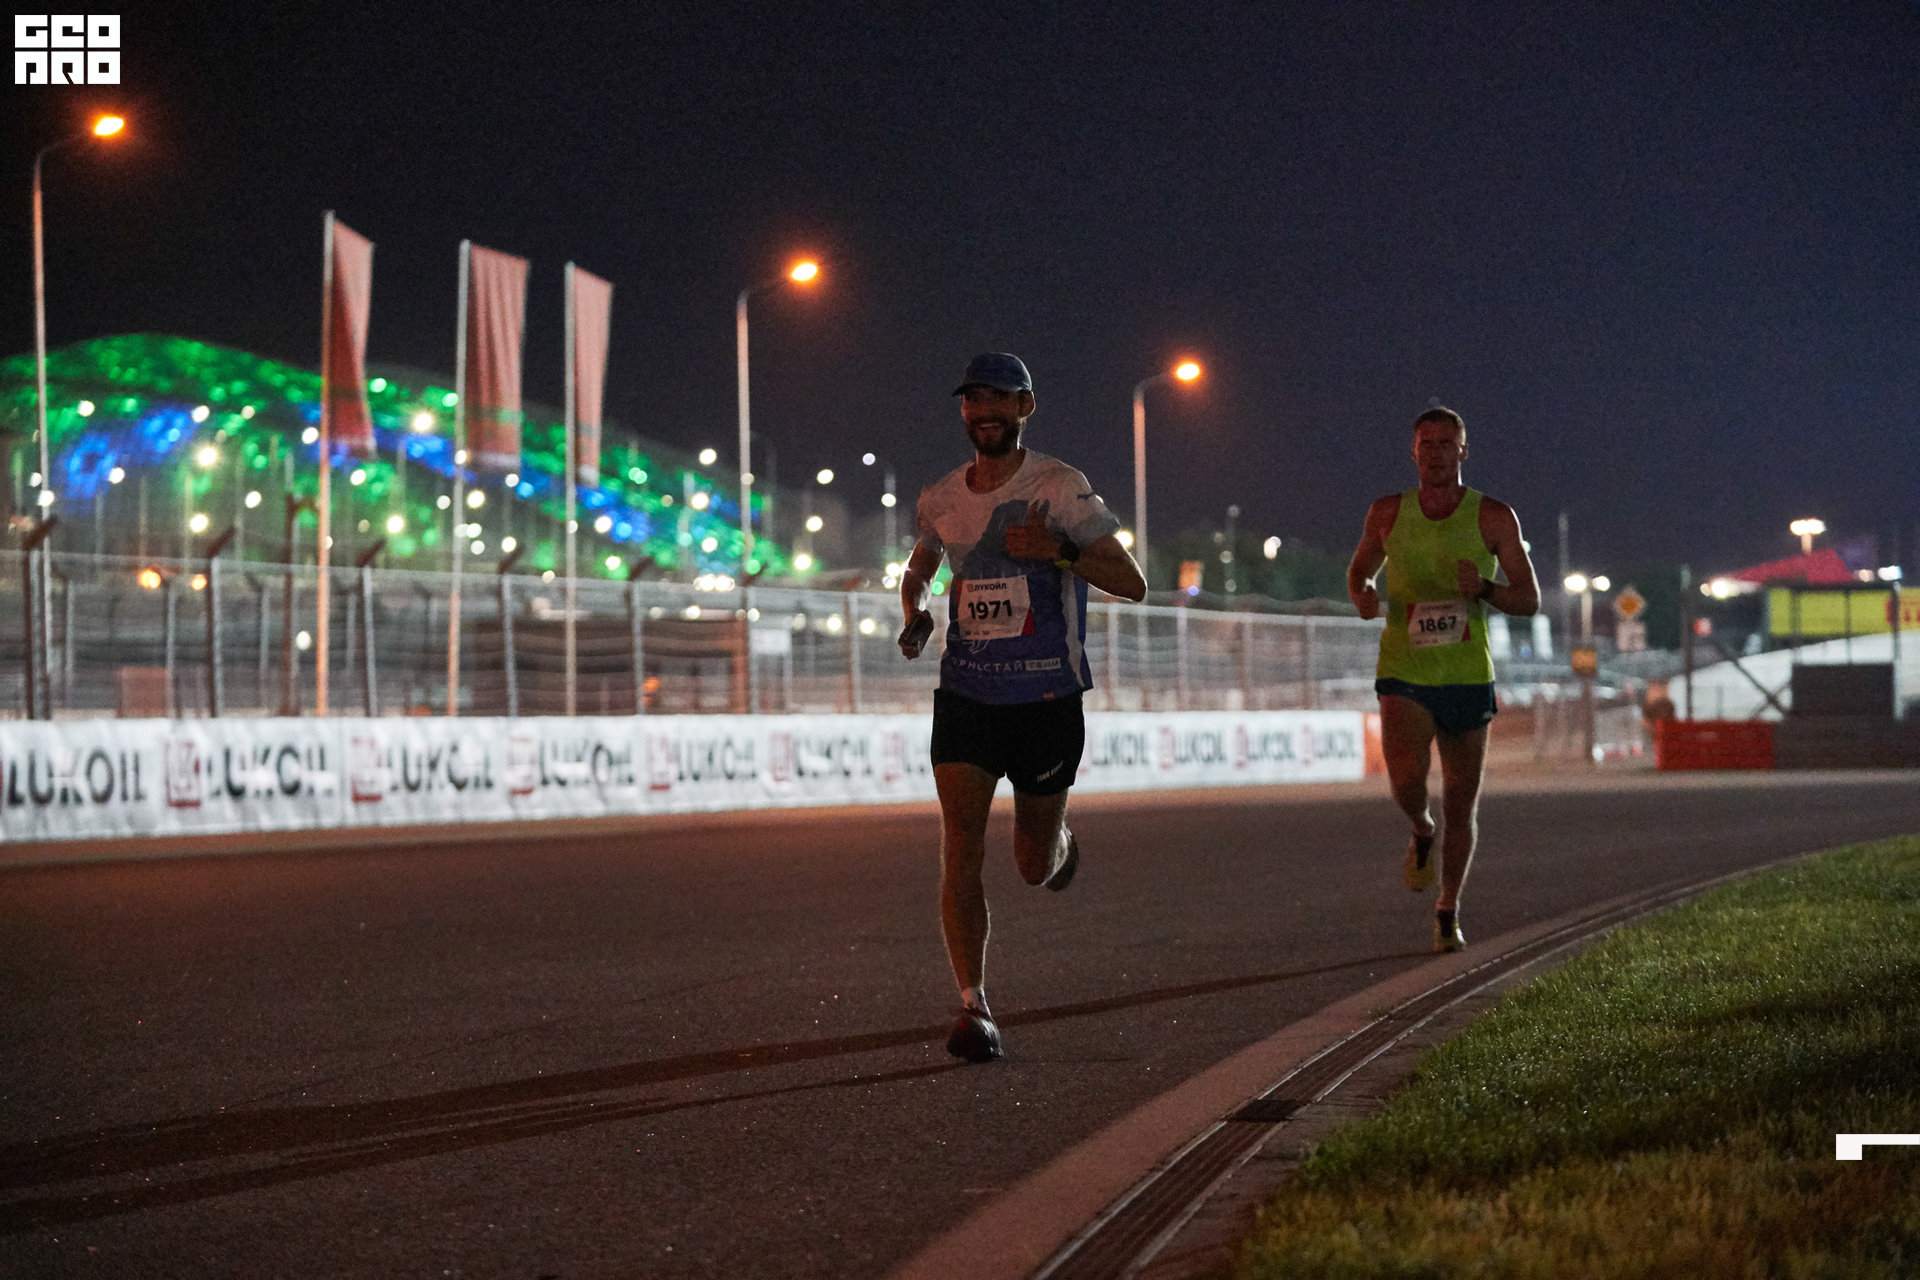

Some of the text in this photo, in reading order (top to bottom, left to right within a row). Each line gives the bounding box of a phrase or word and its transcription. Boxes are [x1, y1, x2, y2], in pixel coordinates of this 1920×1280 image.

[974, 582, 1007, 591] ЛУКОЙЛ
[968, 598, 1013, 619] 1971
[1418, 615, 1457, 634] 1867
[8, 748, 146, 807] LUKOIL
